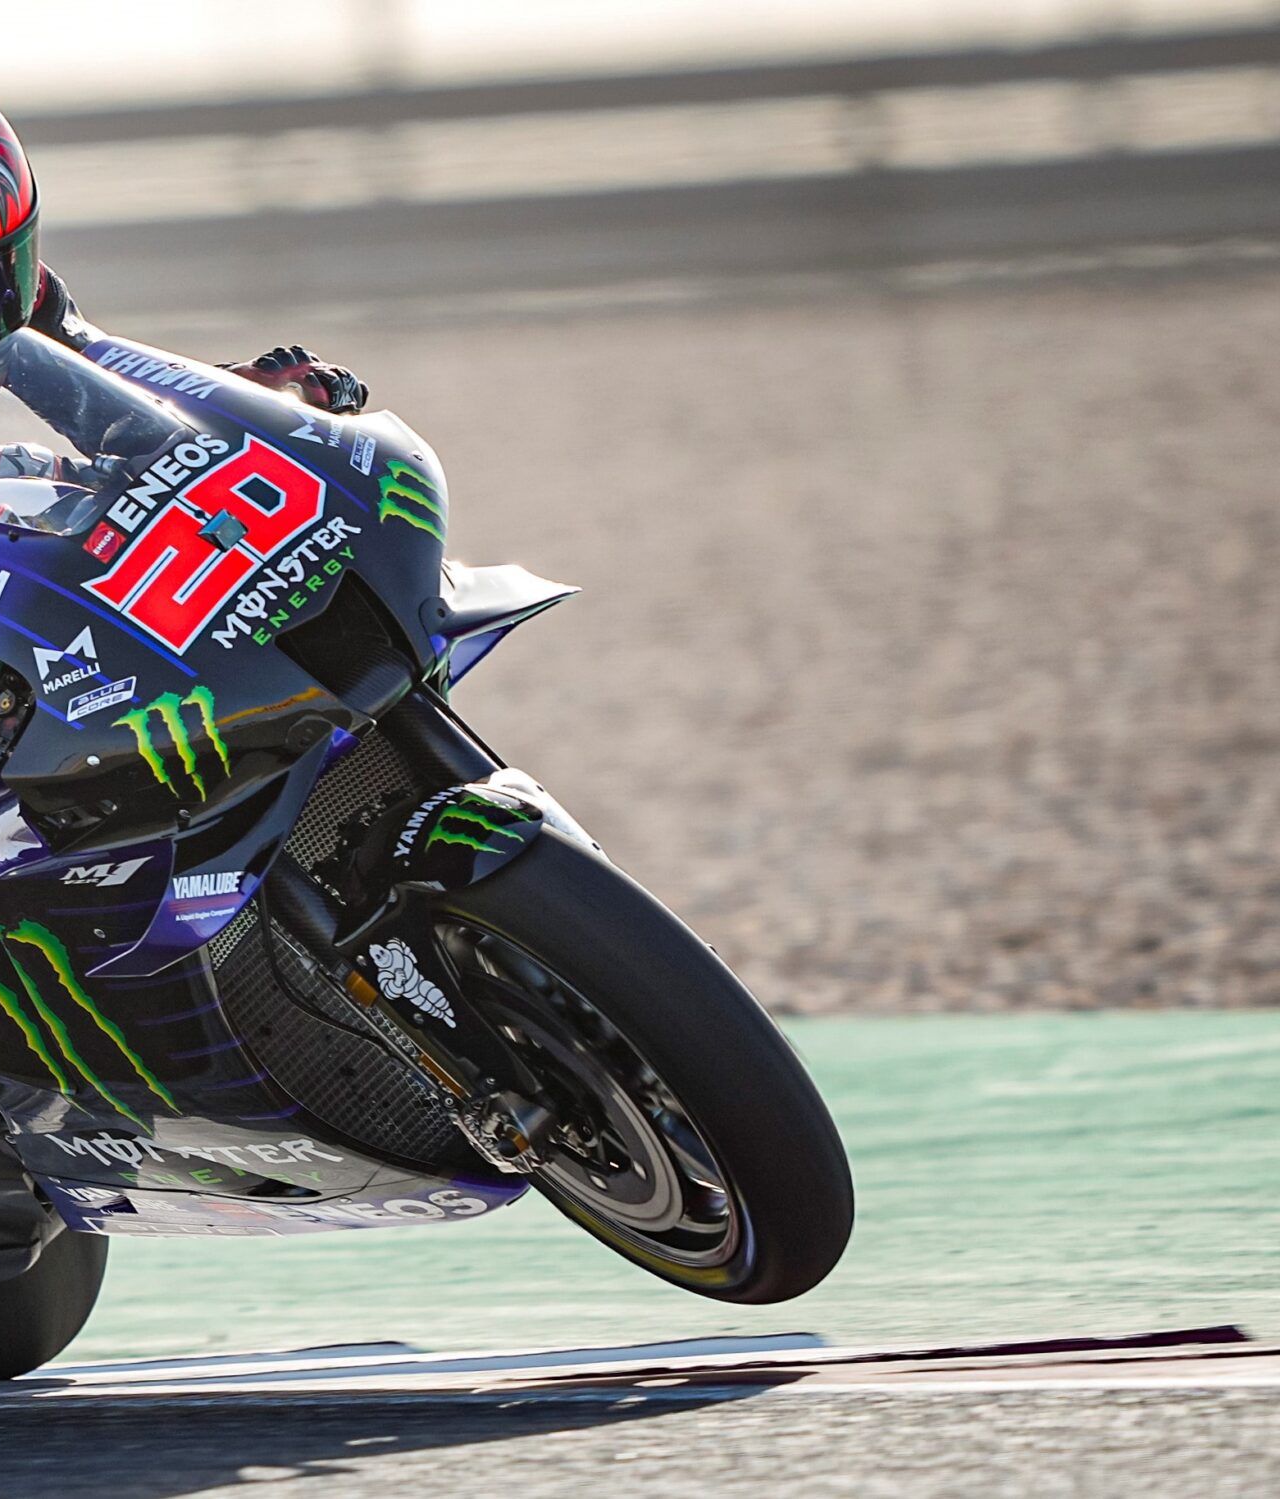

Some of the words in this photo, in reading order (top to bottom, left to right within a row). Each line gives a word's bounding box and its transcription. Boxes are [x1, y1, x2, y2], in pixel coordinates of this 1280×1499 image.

[96, 346, 222, 400] YAMAHA
[107, 433, 230, 533] ENEOS
[80, 432, 327, 657] 20
[93, 531, 115, 555] ENEOS
[210, 515, 362, 650] MONSTER
[252, 545, 356, 646] ENERGY
[42, 661, 101, 695] MARELLI
[77, 682, 125, 706] BLUE
[76, 694, 124, 716] CORE
[393, 785, 464, 858] YAMAHA
[59, 855, 155, 887] M1
[173, 871, 242, 899] YAMALUBE
[250, 1189, 489, 1222] ENEOS
